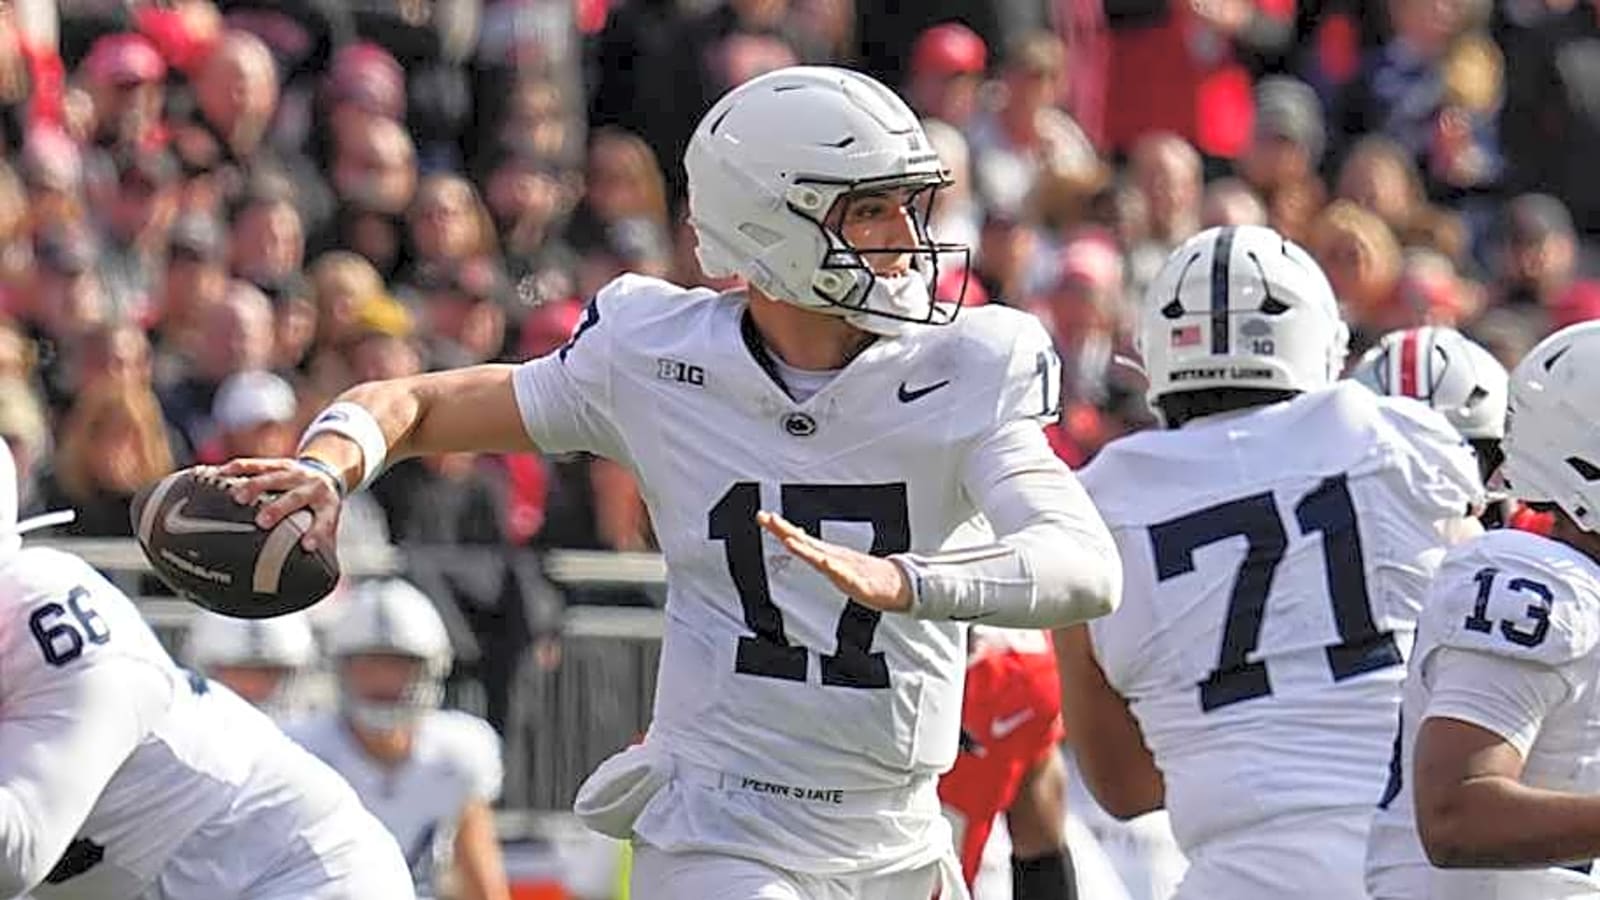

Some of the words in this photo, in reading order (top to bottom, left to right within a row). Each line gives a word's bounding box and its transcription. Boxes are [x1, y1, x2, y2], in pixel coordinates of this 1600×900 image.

[28, 584, 111, 668] 66
[707, 482, 911, 689] 17
[1147, 472, 1404, 712] 71
[1464, 567, 1554, 648] 13
[741, 776, 790, 796] PENN
[793, 785, 844, 804] STATE
